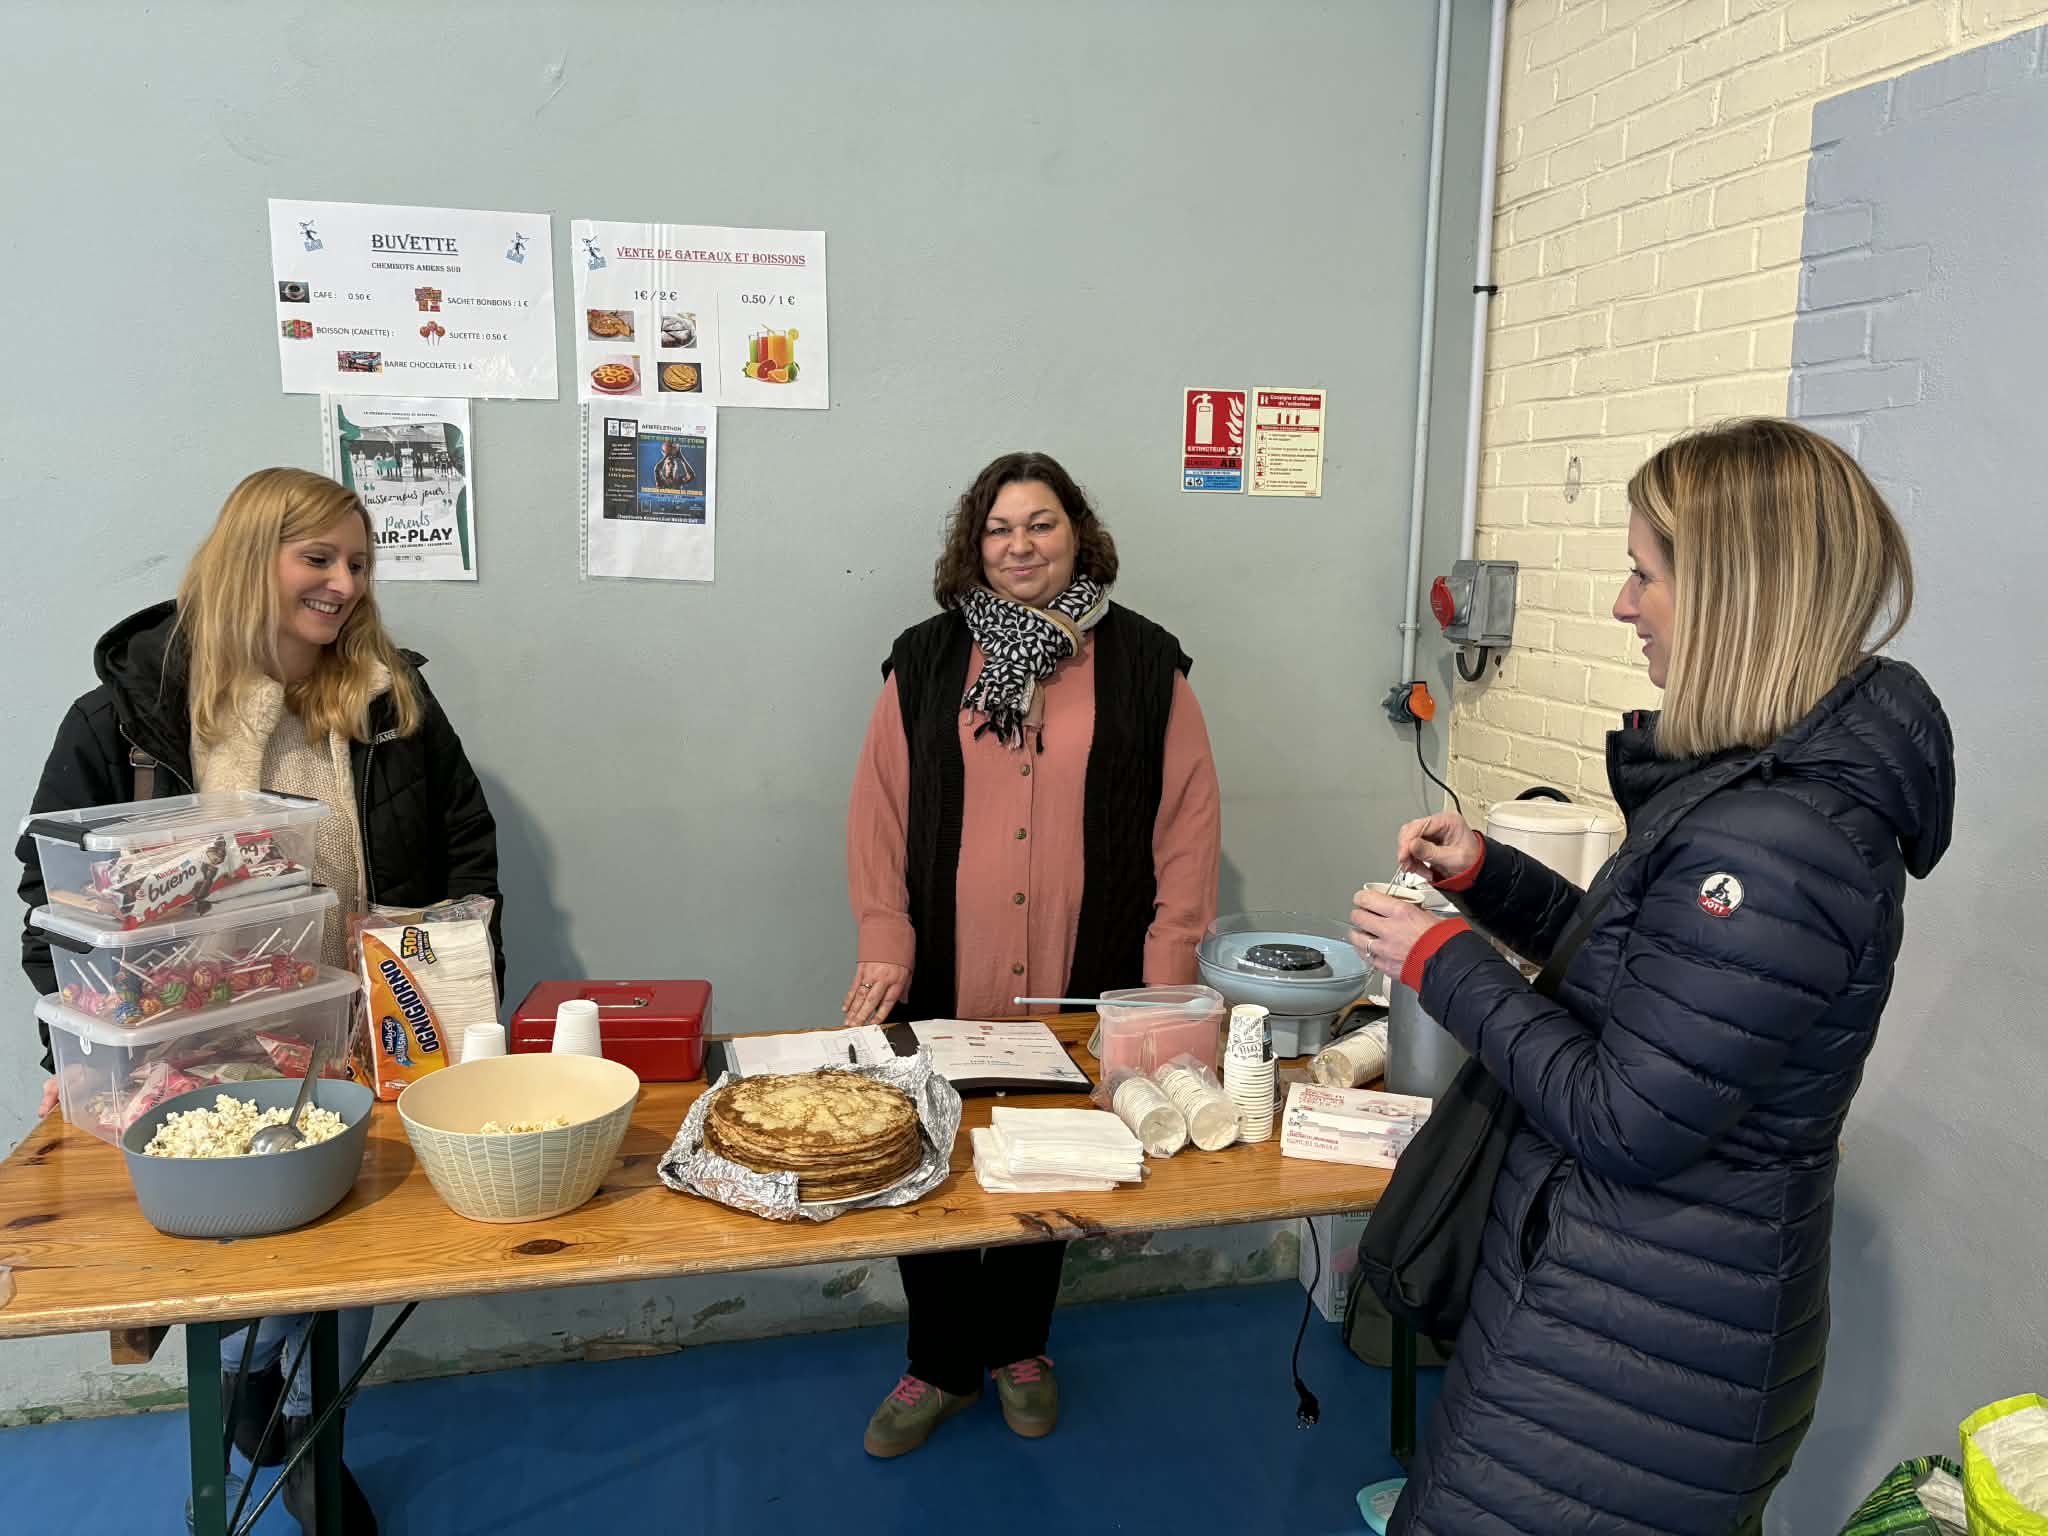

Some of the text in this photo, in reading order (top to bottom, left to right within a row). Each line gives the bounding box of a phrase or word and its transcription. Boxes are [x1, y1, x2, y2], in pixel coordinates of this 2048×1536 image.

[371, 234, 458, 252] BUVETTE
[616, 246, 806, 265] VENTE DE GATEAUX ET BOISSONS
[371, 262, 461, 273] CHEMINOTS AMIENS SUD
[313, 291, 333, 299] CAFE
[659, 291, 667, 301] 2
[669, 291, 678, 301] €
[741, 294, 766, 304] 0.50
[787, 295, 795, 305] €
[447, 297, 475, 305] SACHET
[476, 298, 512, 307] BONBONS
[316, 326, 350, 335] BOISSON
[351, 328, 390, 338] (CANETTE)
[449, 332, 481, 340] SUCETTE
[384, 360, 408, 368] BARRE
[409, 361, 457, 370] CHOCOLATEE
[1187, 445, 1226, 453] EXTINCTEUR
[1220, 458, 1237, 468] AB
[421, 487, 446, 507] jouer
[371, 528, 453, 544] AIR-PLAY
[148, 864, 196, 902] bueno
[1702, 899, 1725, 913] JOTT
[402, 928, 417, 957] 500
[380, 959, 440, 1053] OGNIGIORNO
